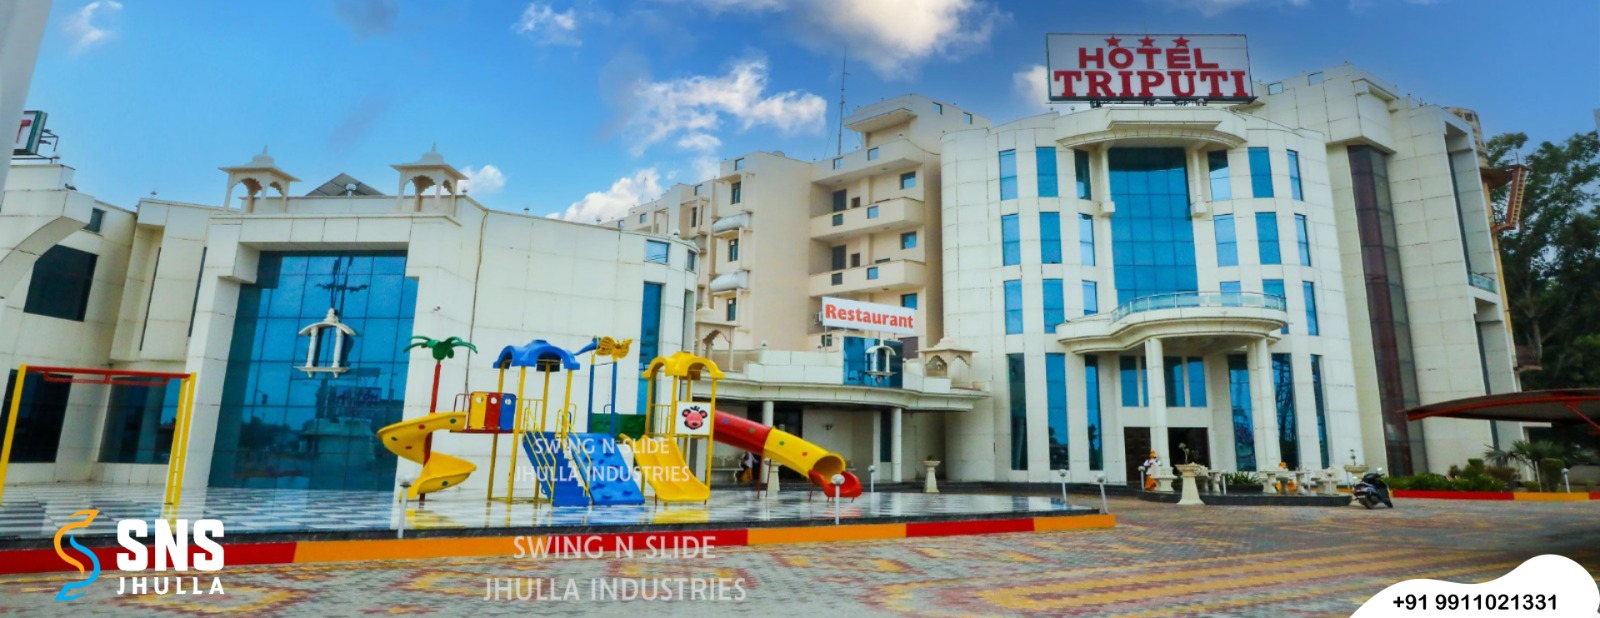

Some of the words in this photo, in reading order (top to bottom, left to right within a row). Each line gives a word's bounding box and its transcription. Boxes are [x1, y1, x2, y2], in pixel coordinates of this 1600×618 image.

[1078, 47, 1219, 69] HOTEL
[1053, 70, 1249, 97] TRIPUTI
[825, 303, 914, 329] Restaurant
